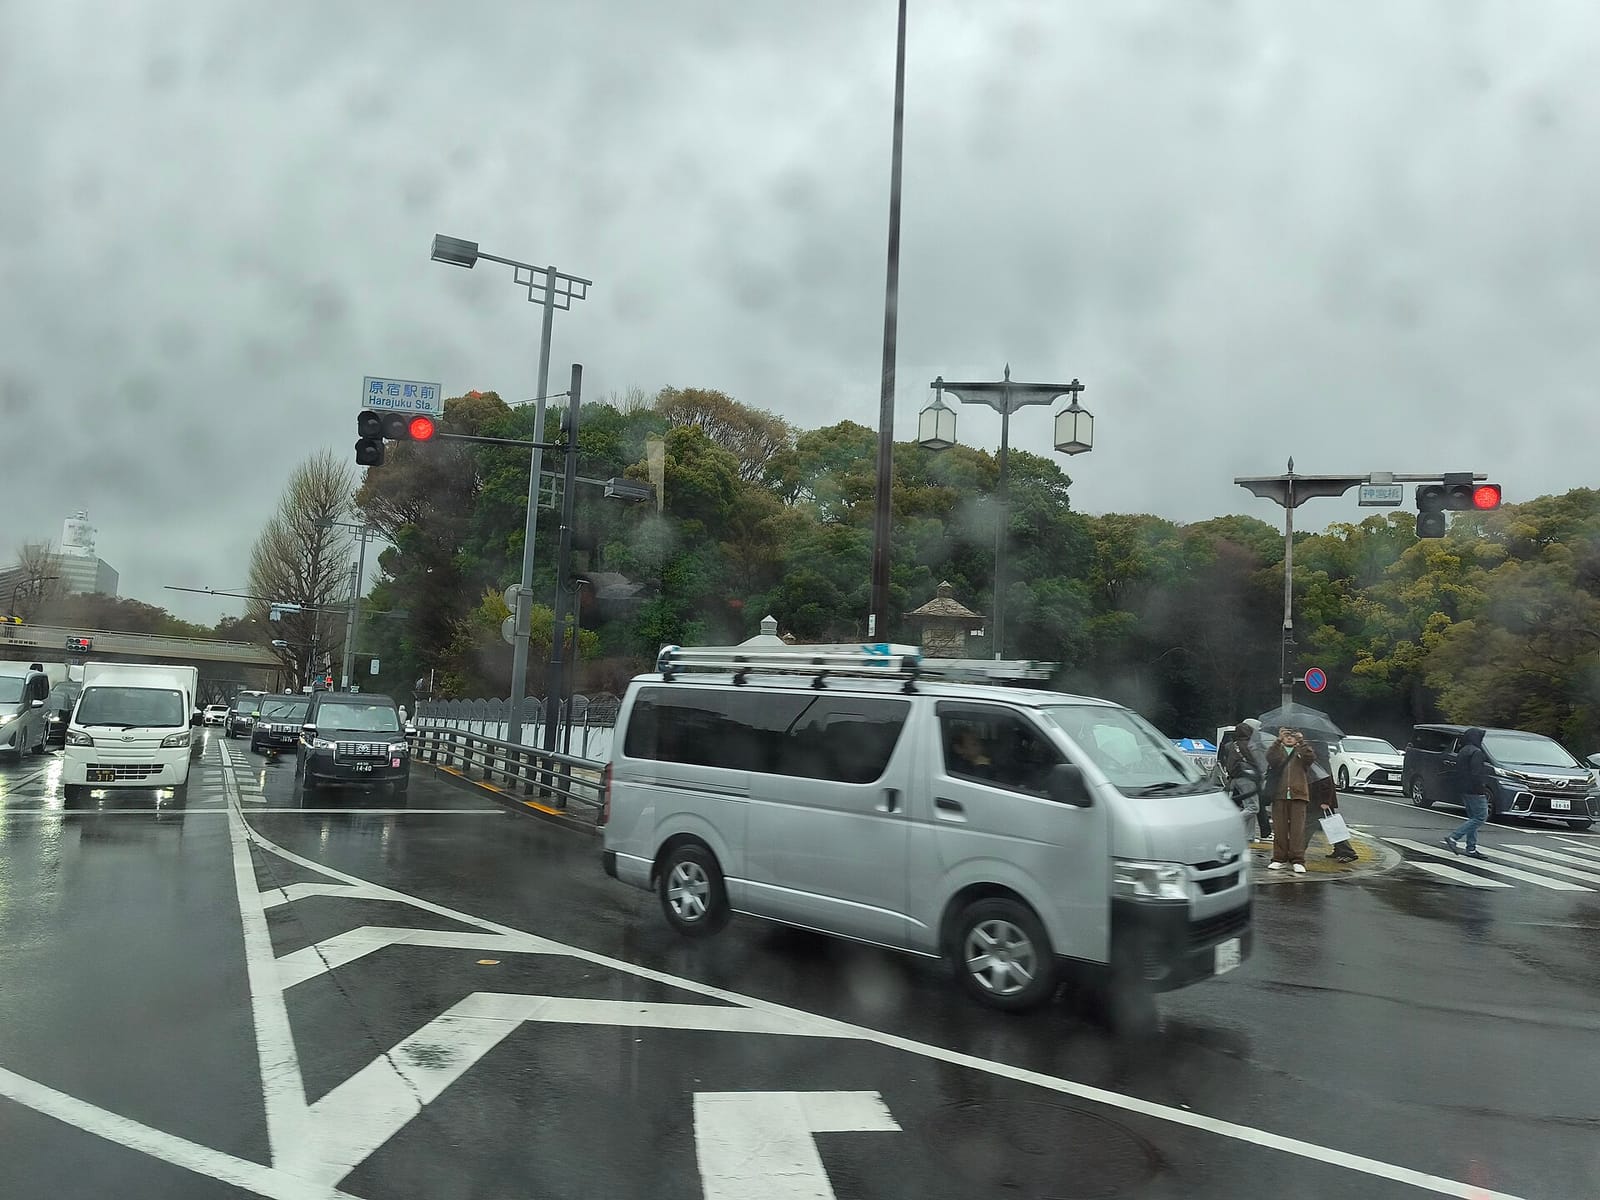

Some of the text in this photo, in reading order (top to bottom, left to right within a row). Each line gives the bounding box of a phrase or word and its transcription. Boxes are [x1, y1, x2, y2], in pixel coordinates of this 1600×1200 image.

[369, 381, 435, 399] 原宿駅前
[369, 395, 433, 410] Harajuku Sta.
